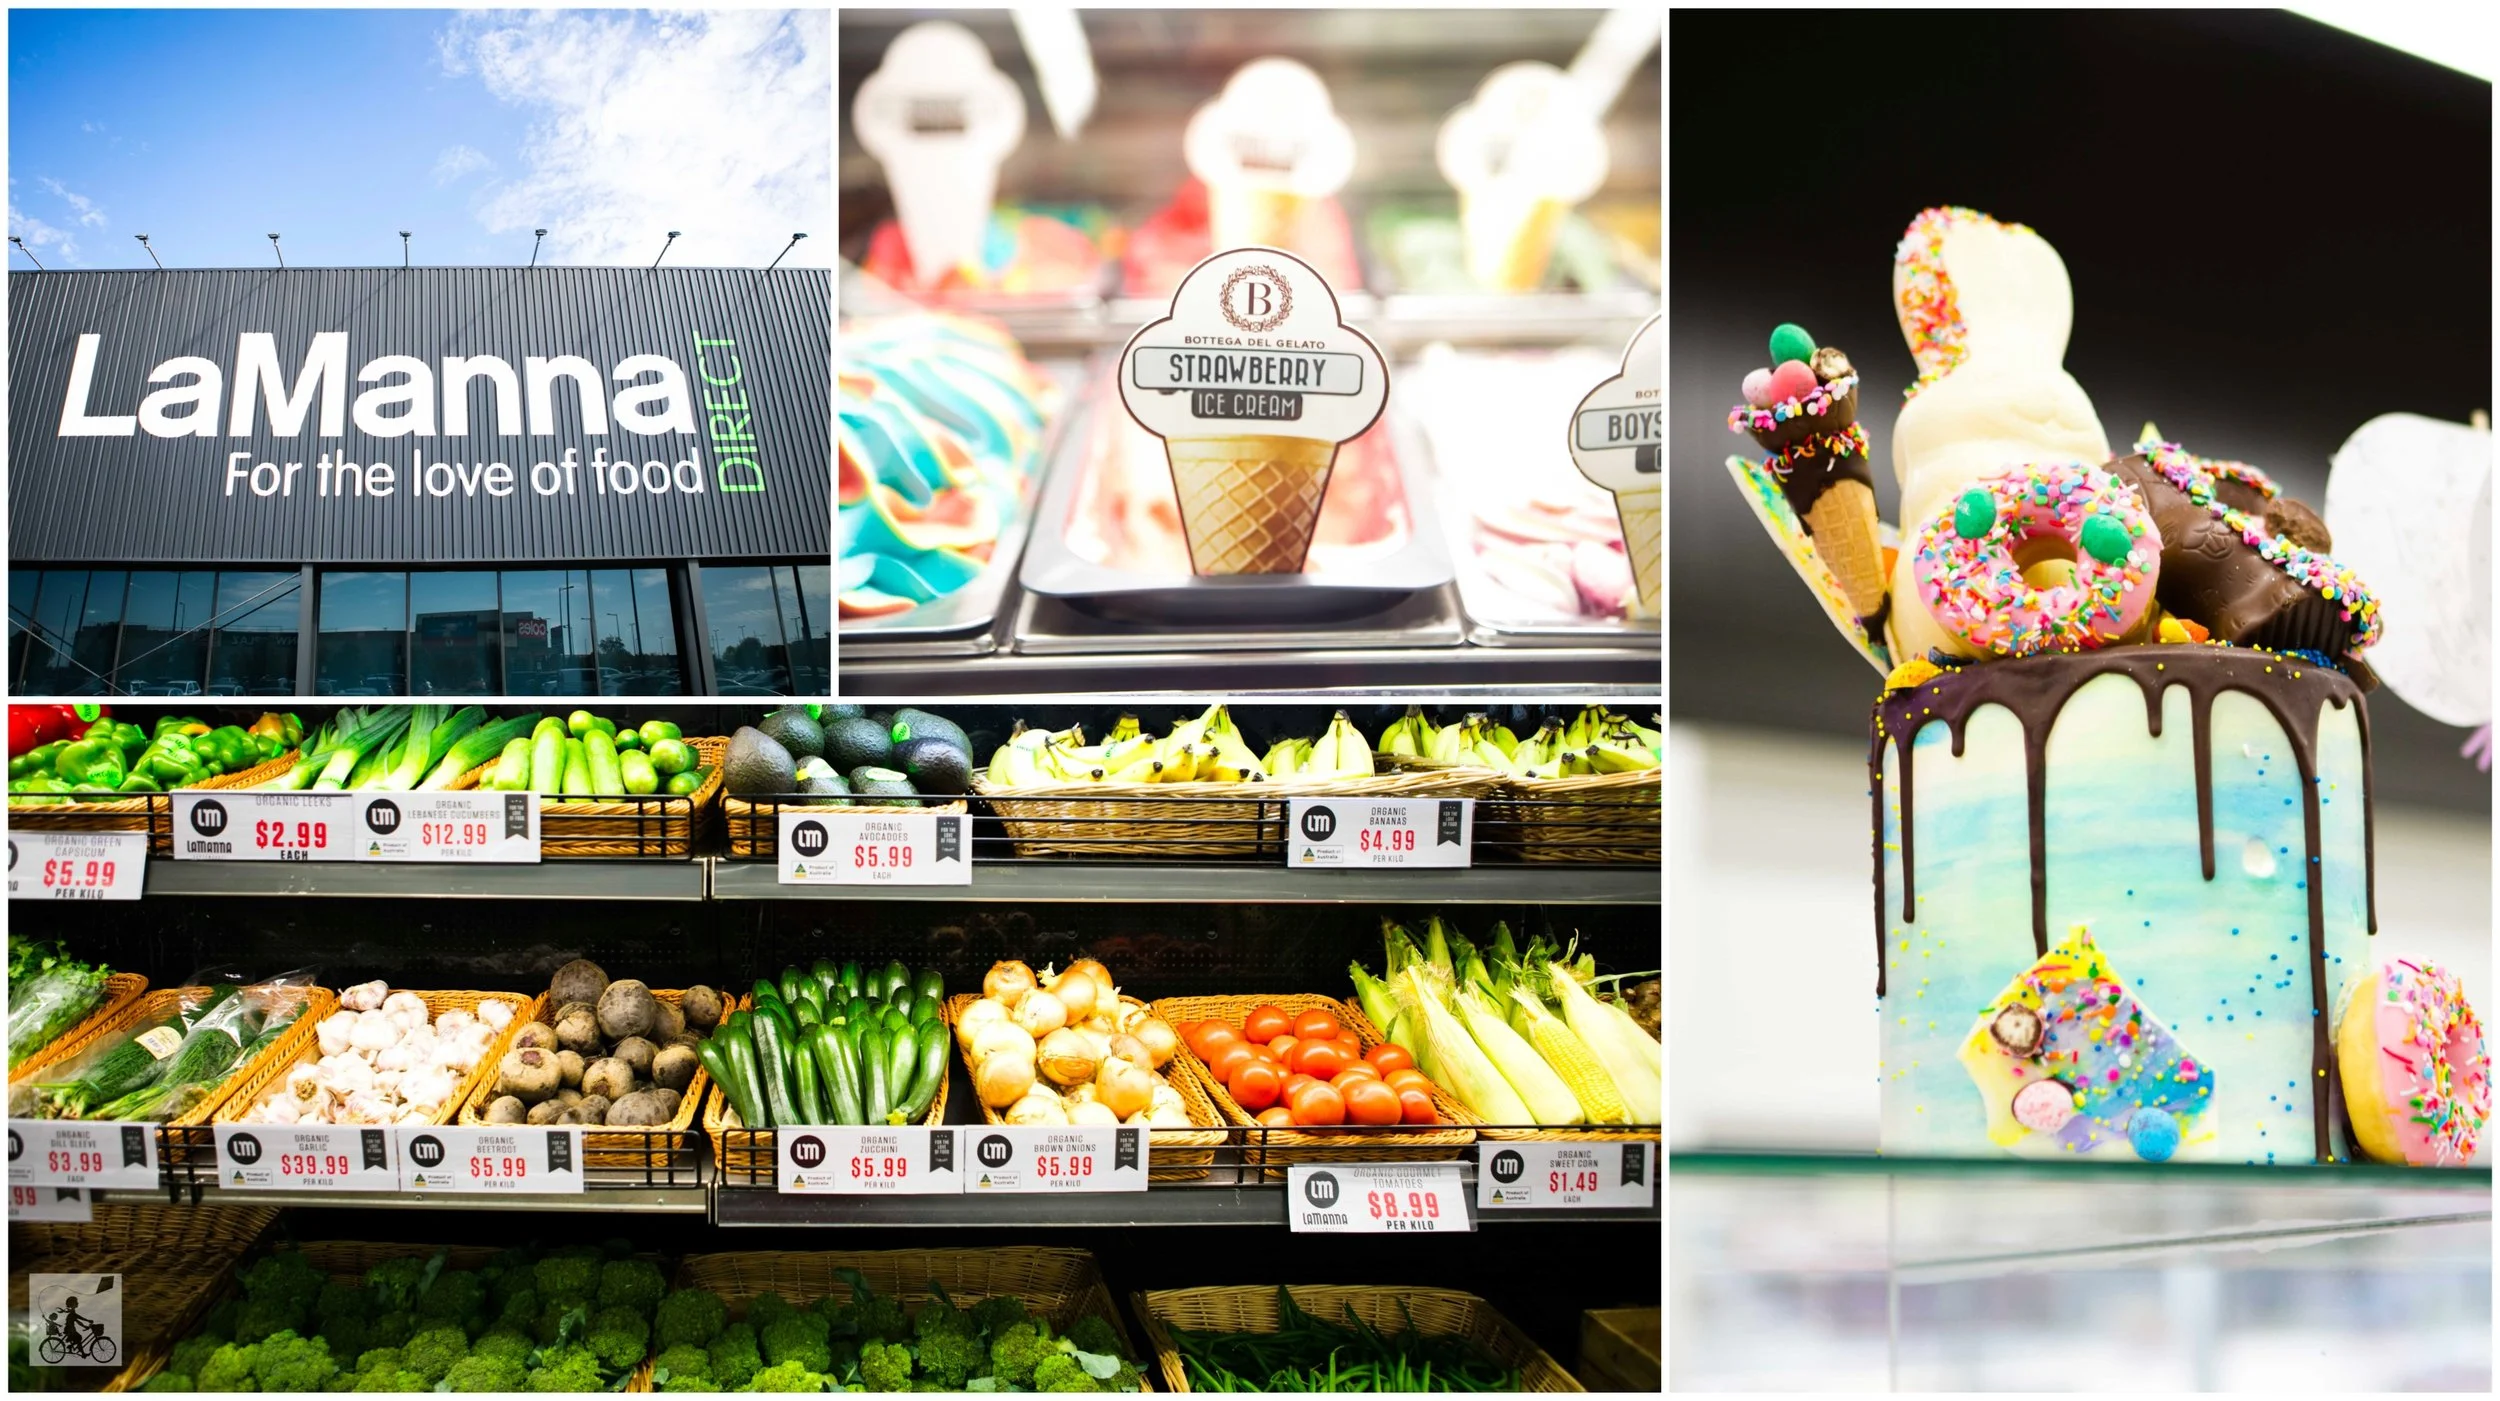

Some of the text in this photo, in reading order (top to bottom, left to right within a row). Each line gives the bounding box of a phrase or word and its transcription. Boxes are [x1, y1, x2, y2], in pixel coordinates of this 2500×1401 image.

[1244, 282, 1272, 316] B
[1184, 335, 1325, 349] BOTTEGA DEL GELATO
[1169, 353, 1327, 387] STRAWBERRY
[58, 331, 697, 437] LaManna
[1198, 393, 1296, 417] ICE CREAM
[693, 330, 766, 494] DIRECT
[225, 447, 704, 497] For the love of food
[256, 796, 332, 807] ORGANIC LEEKS
[436, 800, 472, 809] ORGANIC
[408, 810, 501, 819] LEBANESE CUCUMBERS
[1371, 807, 1407, 816] ORGANIC
[1370, 817, 1407, 825] BANANAS
[865, 823, 902, 831] ORGANIC
[256, 820, 327, 849] $2.99
[422, 822, 487, 846] $12.99
[859, 832, 908, 841] AVOCADOES
[44, 836, 122, 847] ORGANIC GREEN
[1360, 828, 1415, 852] $4.99
[55, 847, 106, 858] CAPSICUM
[280, 850, 308, 860] EACH
[441, 849, 473, 857] PER KILO
[854, 845, 912, 868] $5.99
[1373, 855, 1404, 863] PER KILO
[42, 858, 116, 887] $5.99
[55, 888, 105, 900] PER KILO
[56, 1130, 90, 1139] ORGANIC
[294, 1134, 330, 1143] ORGANIC
[1048, 1135, 1084, 1144] ORGANIC
[51, 1140, 97, 1148] DILL SLEEVE
[478, 1136, 514, 1144] ORGANIC
[861, 1136, 897, 1144] ORGANIC
[298, 1143, 328, 1152] GARLIC
[477, 1146, 517, 1154] BEETROOT
[860, 1146, 898, 1154] ZUCCHINI
[1034, 1144, 1096, 1153] BROWN ONIONS
[1558, 1151, 1592, 1159] ORGANIC
[49, 1151, 103, 1172] $3.99
[282, 1154, 349, 1176] $39.99
[1037, 1155, 1092, 1178] $5.99
[1550, 1160, 1599, 1168] SWEET CORN
[470, 1156, 526, 1178] $5.99
[851, 1157, 907, 1178] $5.99
[1354, 1168, 1442, 1177] ORGANIC GOURMET
[67, 1175, 85, 1183] EACH
[303, 1178, 334, 1186] PER KILO
[1374, 1179, 1424, 1189] TOMATOES
[1550, 1171, 1598, 1194] $1.49
[1368, 1190, 1440, 1220] $8.99
[1387, 1221, 1434, 1230] PER KILO
